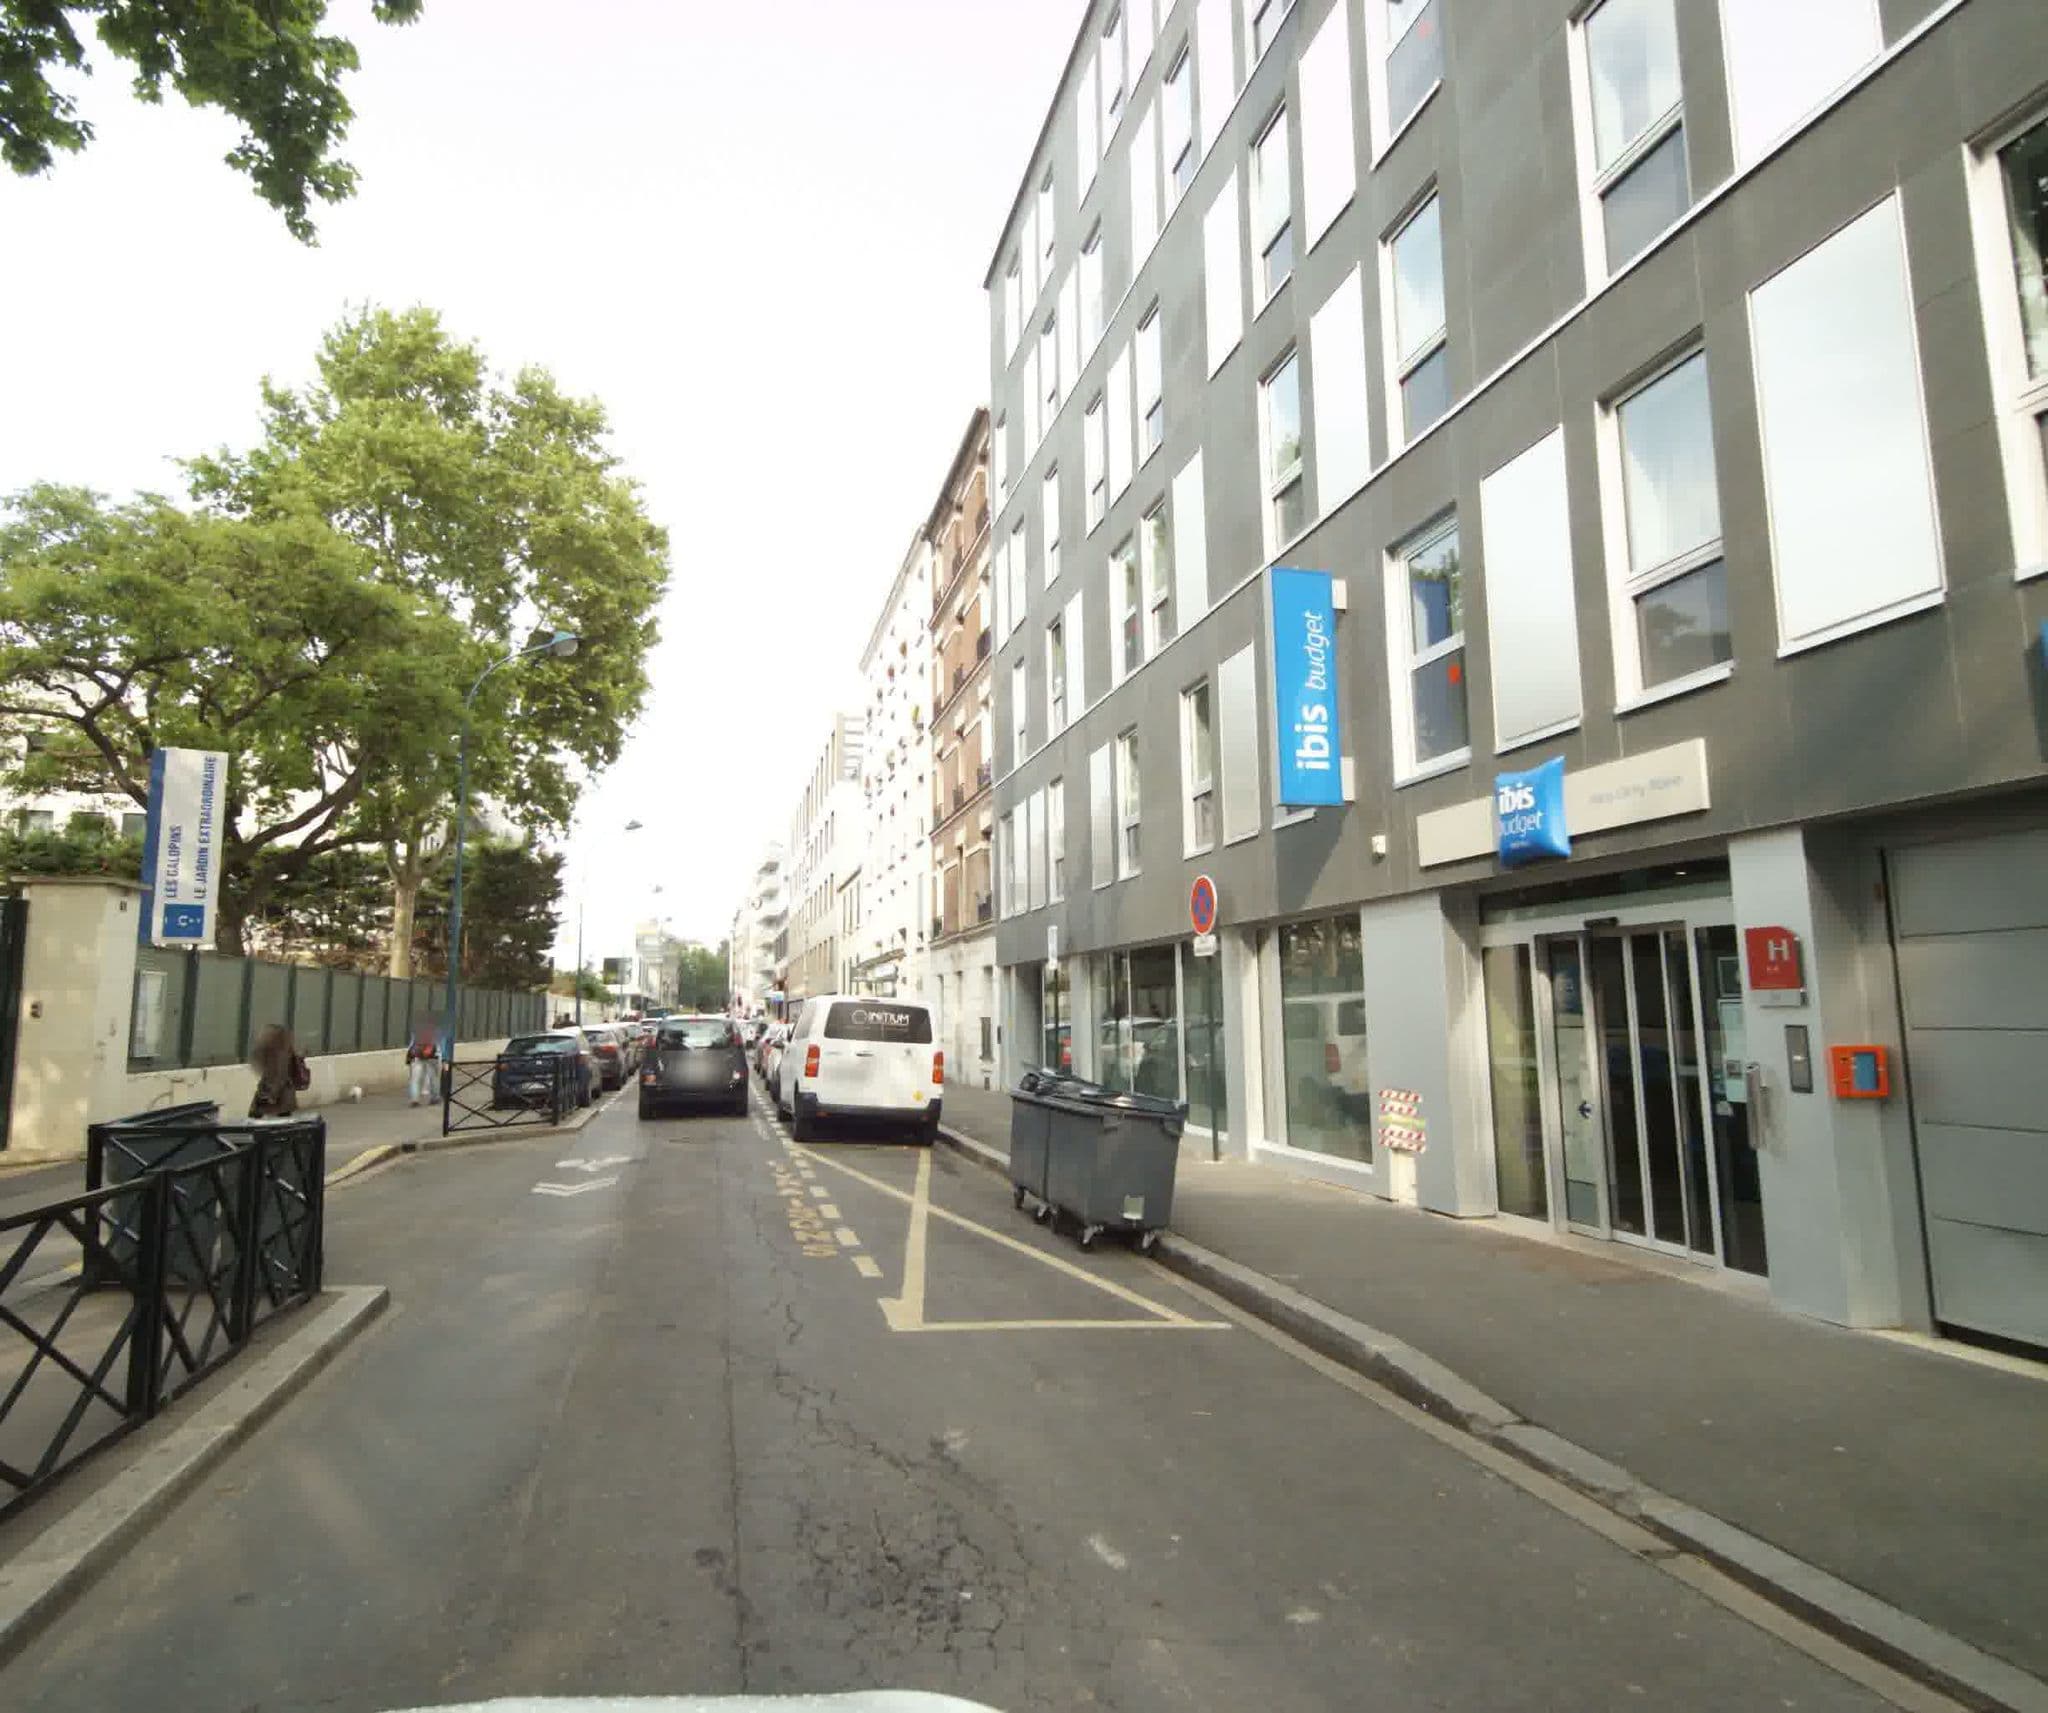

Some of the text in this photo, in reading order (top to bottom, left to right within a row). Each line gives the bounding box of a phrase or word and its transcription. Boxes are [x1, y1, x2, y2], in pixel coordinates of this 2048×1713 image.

[1295, 609, 1330, 770] ibis budget
[165, 878, 177, 898] LES
[193, 885, 206, 899] LE
[1768, 939, 1789, 961] H
